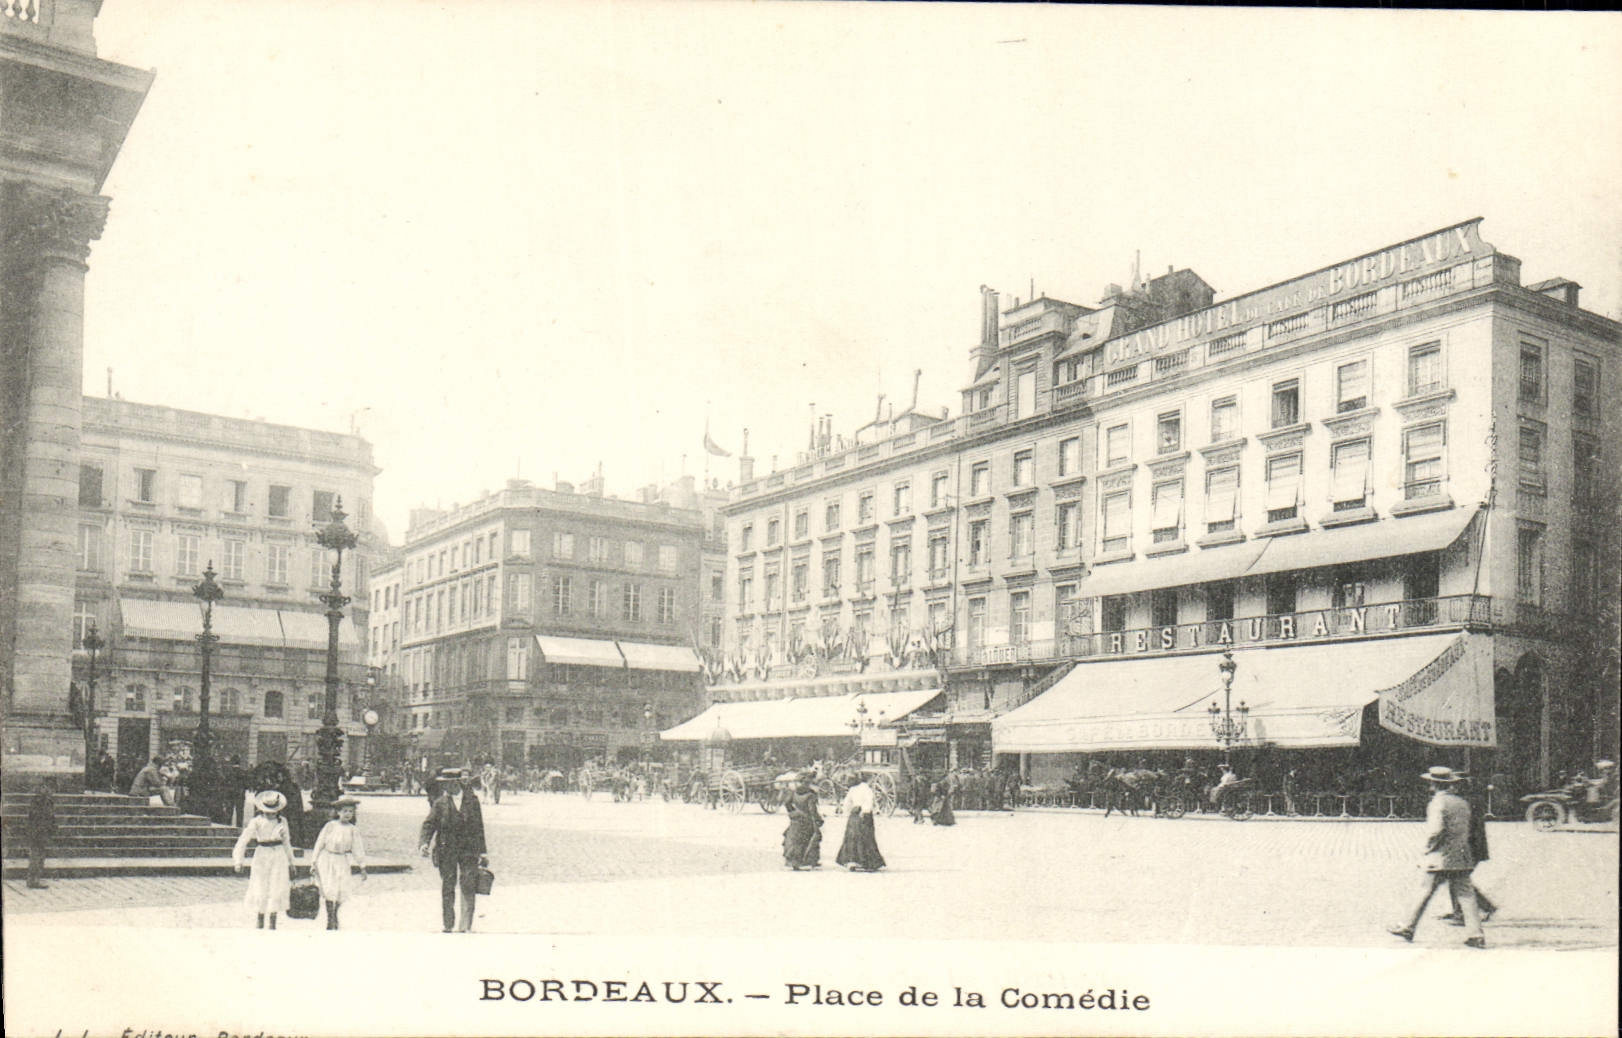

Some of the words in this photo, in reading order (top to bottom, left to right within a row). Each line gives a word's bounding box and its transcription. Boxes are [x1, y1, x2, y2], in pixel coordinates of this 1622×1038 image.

[1103, 325, 1170, 365] GRAND
[1177, 301, 1241, 341] HOTEL
[1329, 226, 1472, 296] BORDEAUX
[1110, 604, 1400, 654] RESTAURANT
[1385, 700, 1491, 741] RESTAURANT
